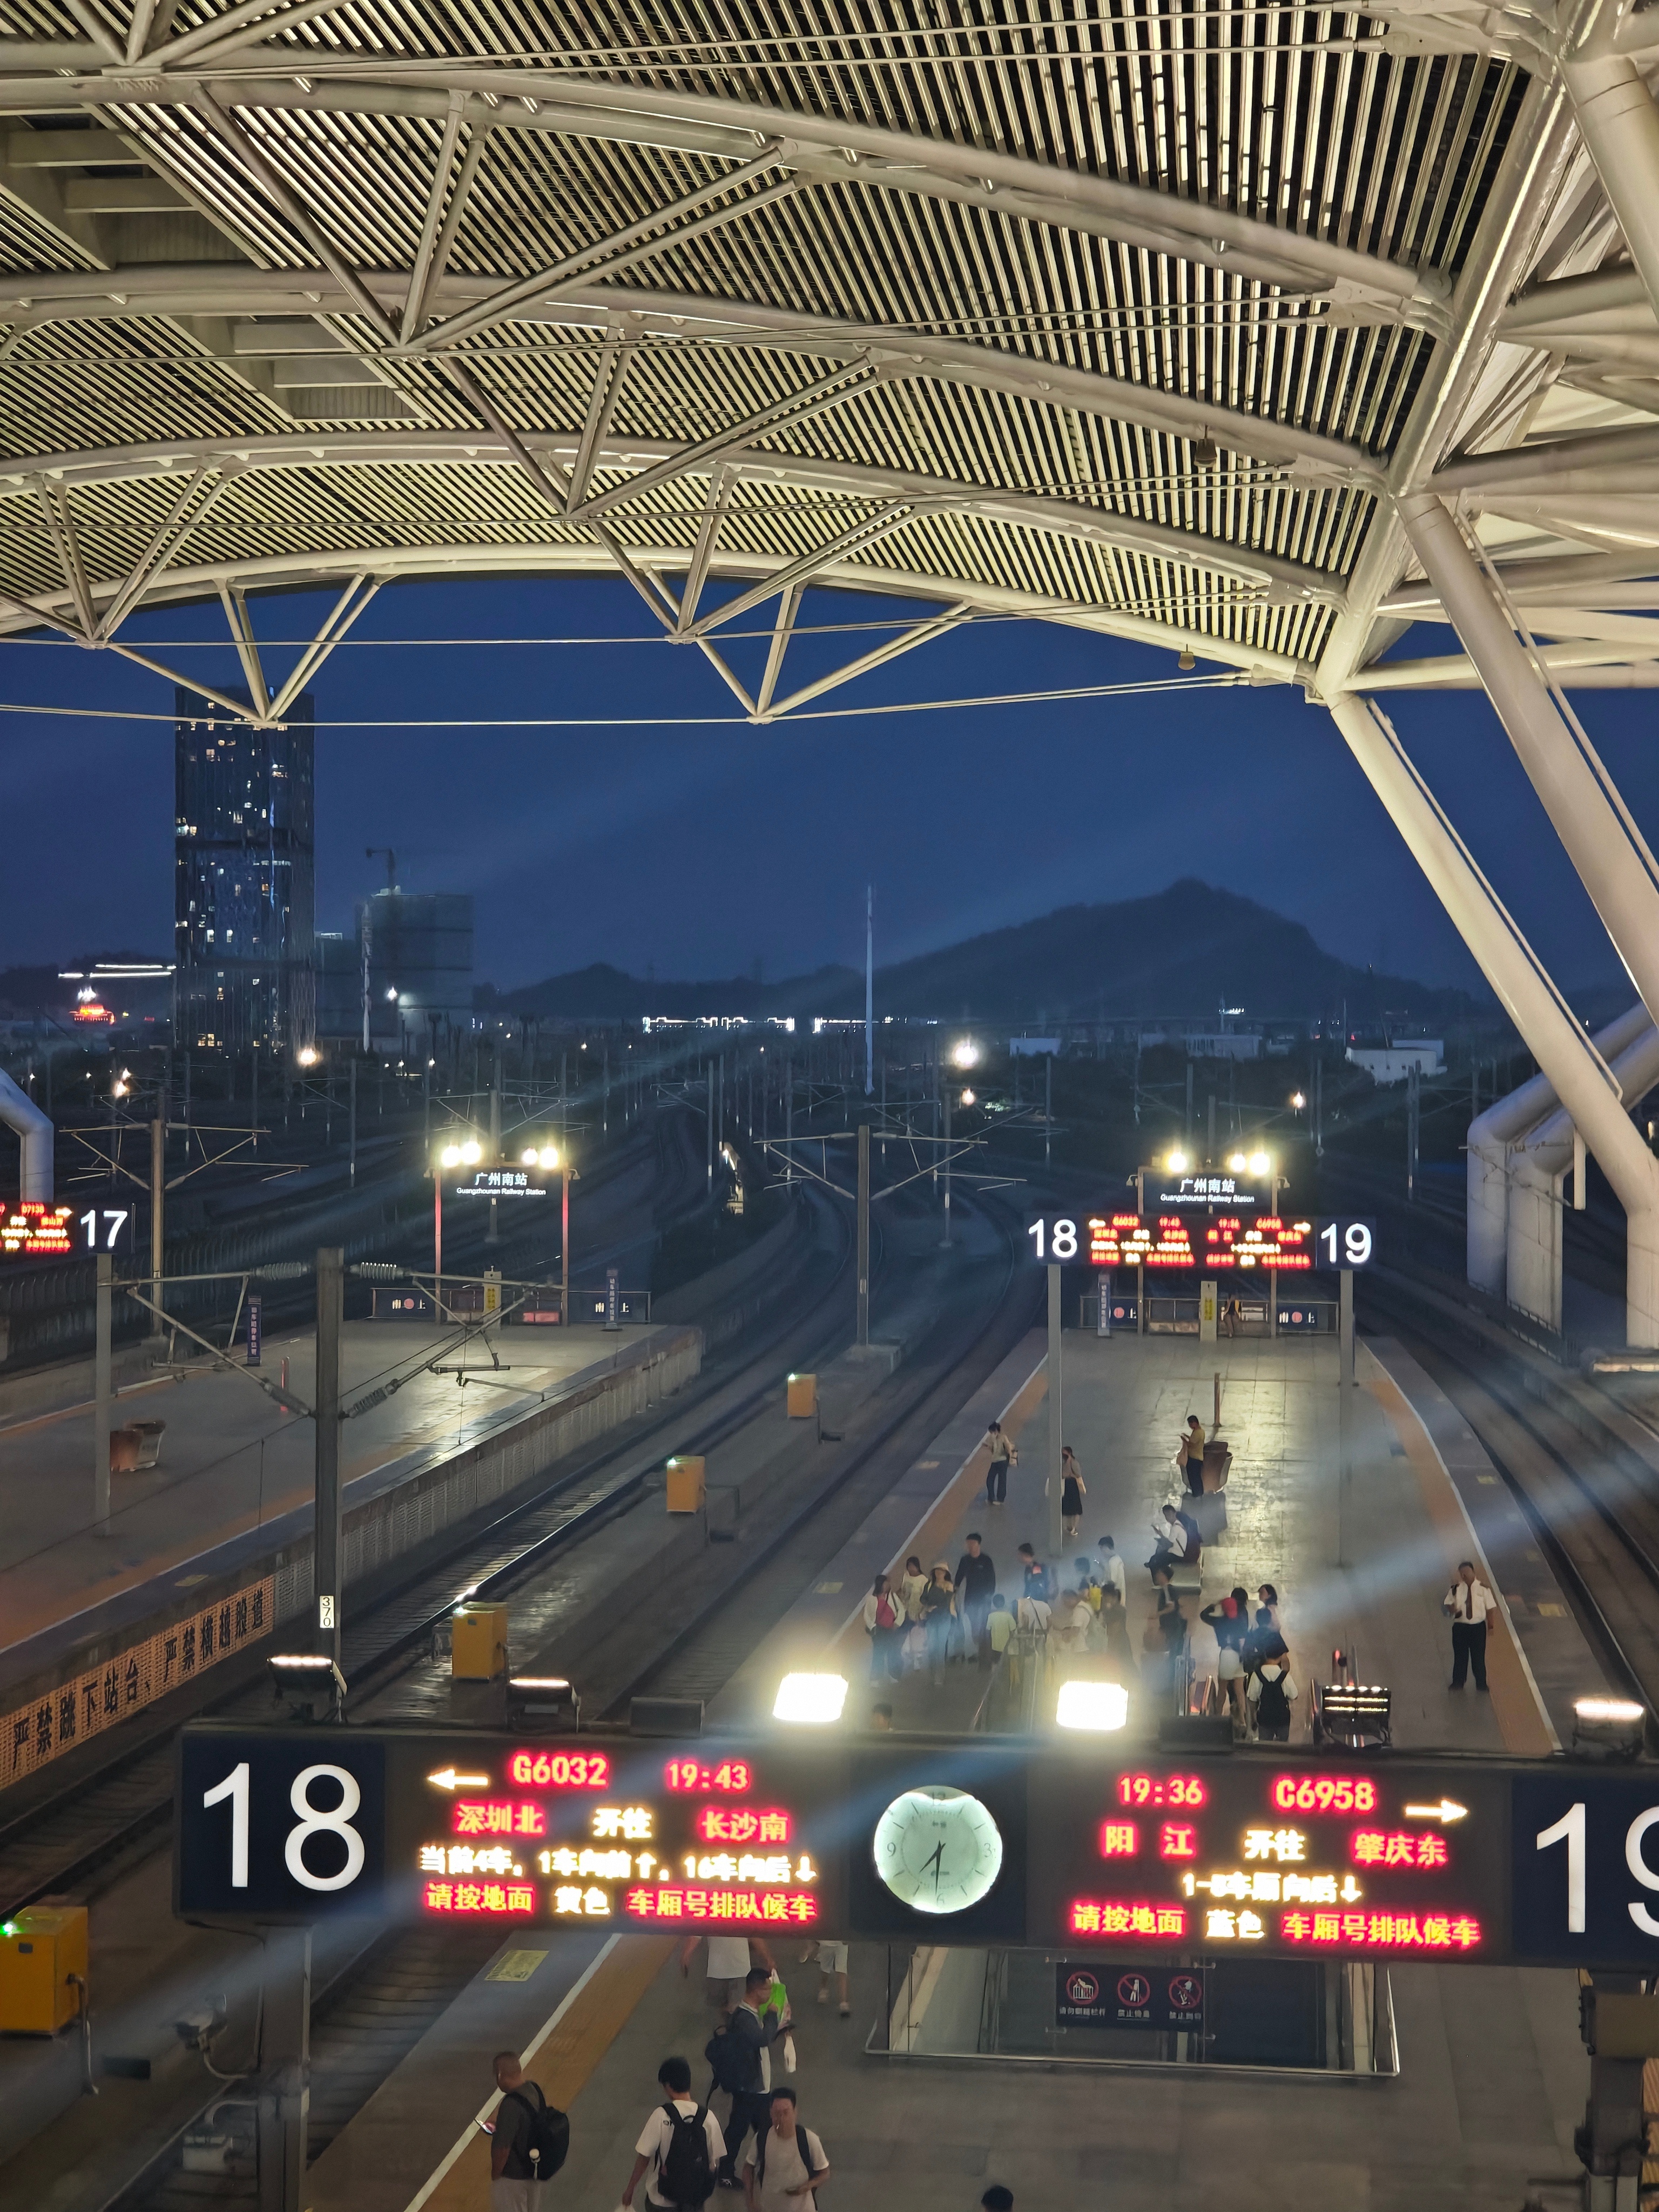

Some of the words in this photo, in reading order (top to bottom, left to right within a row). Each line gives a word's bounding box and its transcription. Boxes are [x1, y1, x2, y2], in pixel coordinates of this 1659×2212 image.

[456, 1187, 501, 1196] Guangzhounan
[501, 1188, 524, 1196] Railway
[525, 1188, 547, 1196] Station
[475, 1171, 529, 1186] 广州南站
[1179, 1177, 1236, 1193] 广州南站
[1160, 1192, 1206, 1203] Guangzhounan
[1208, 1193, 1231, 1204] Railway
[1233, 1194, 1255, 1203] Station
[80, 1209, 128, 1248] 17
[1028, 1218, 1078, 1259] 18
[1321, 1223, 1372, 1264] 19
[322, 1596, 331, 1627] 370
[512, 1754, 608, 1786] G6032
[668, 1762, 749, 1790] 19:43
[1120, 1776, 1204, 1805] 19:36
[1275, 1778, 1375, 1811] C6958
[203, 1762, 366, 1892] 18
[456, 1803, 544, 1835] 深圳北
[591, 1806, 653, 1840] 开往
[700, 1810, 789, 1843] 长沙南
[886, 1842, 896, 1858] 9
[1243, 1828, 1307, 1863] 开往
[1354, 1832, 1447, 1866] 肇庆东
[425, 1882, 534, 1913] 请按地面
[553, 1885, 611, 1916] 黄色
[628, 1889, 816, 1922] 车厢号排队候车
[1072, 1903, 1185, 1936] 请按地面
[1205, 1908, 1266, 1940] 蓝色
[1283, 1912, 1480, 1947] 车厢号排队候车
